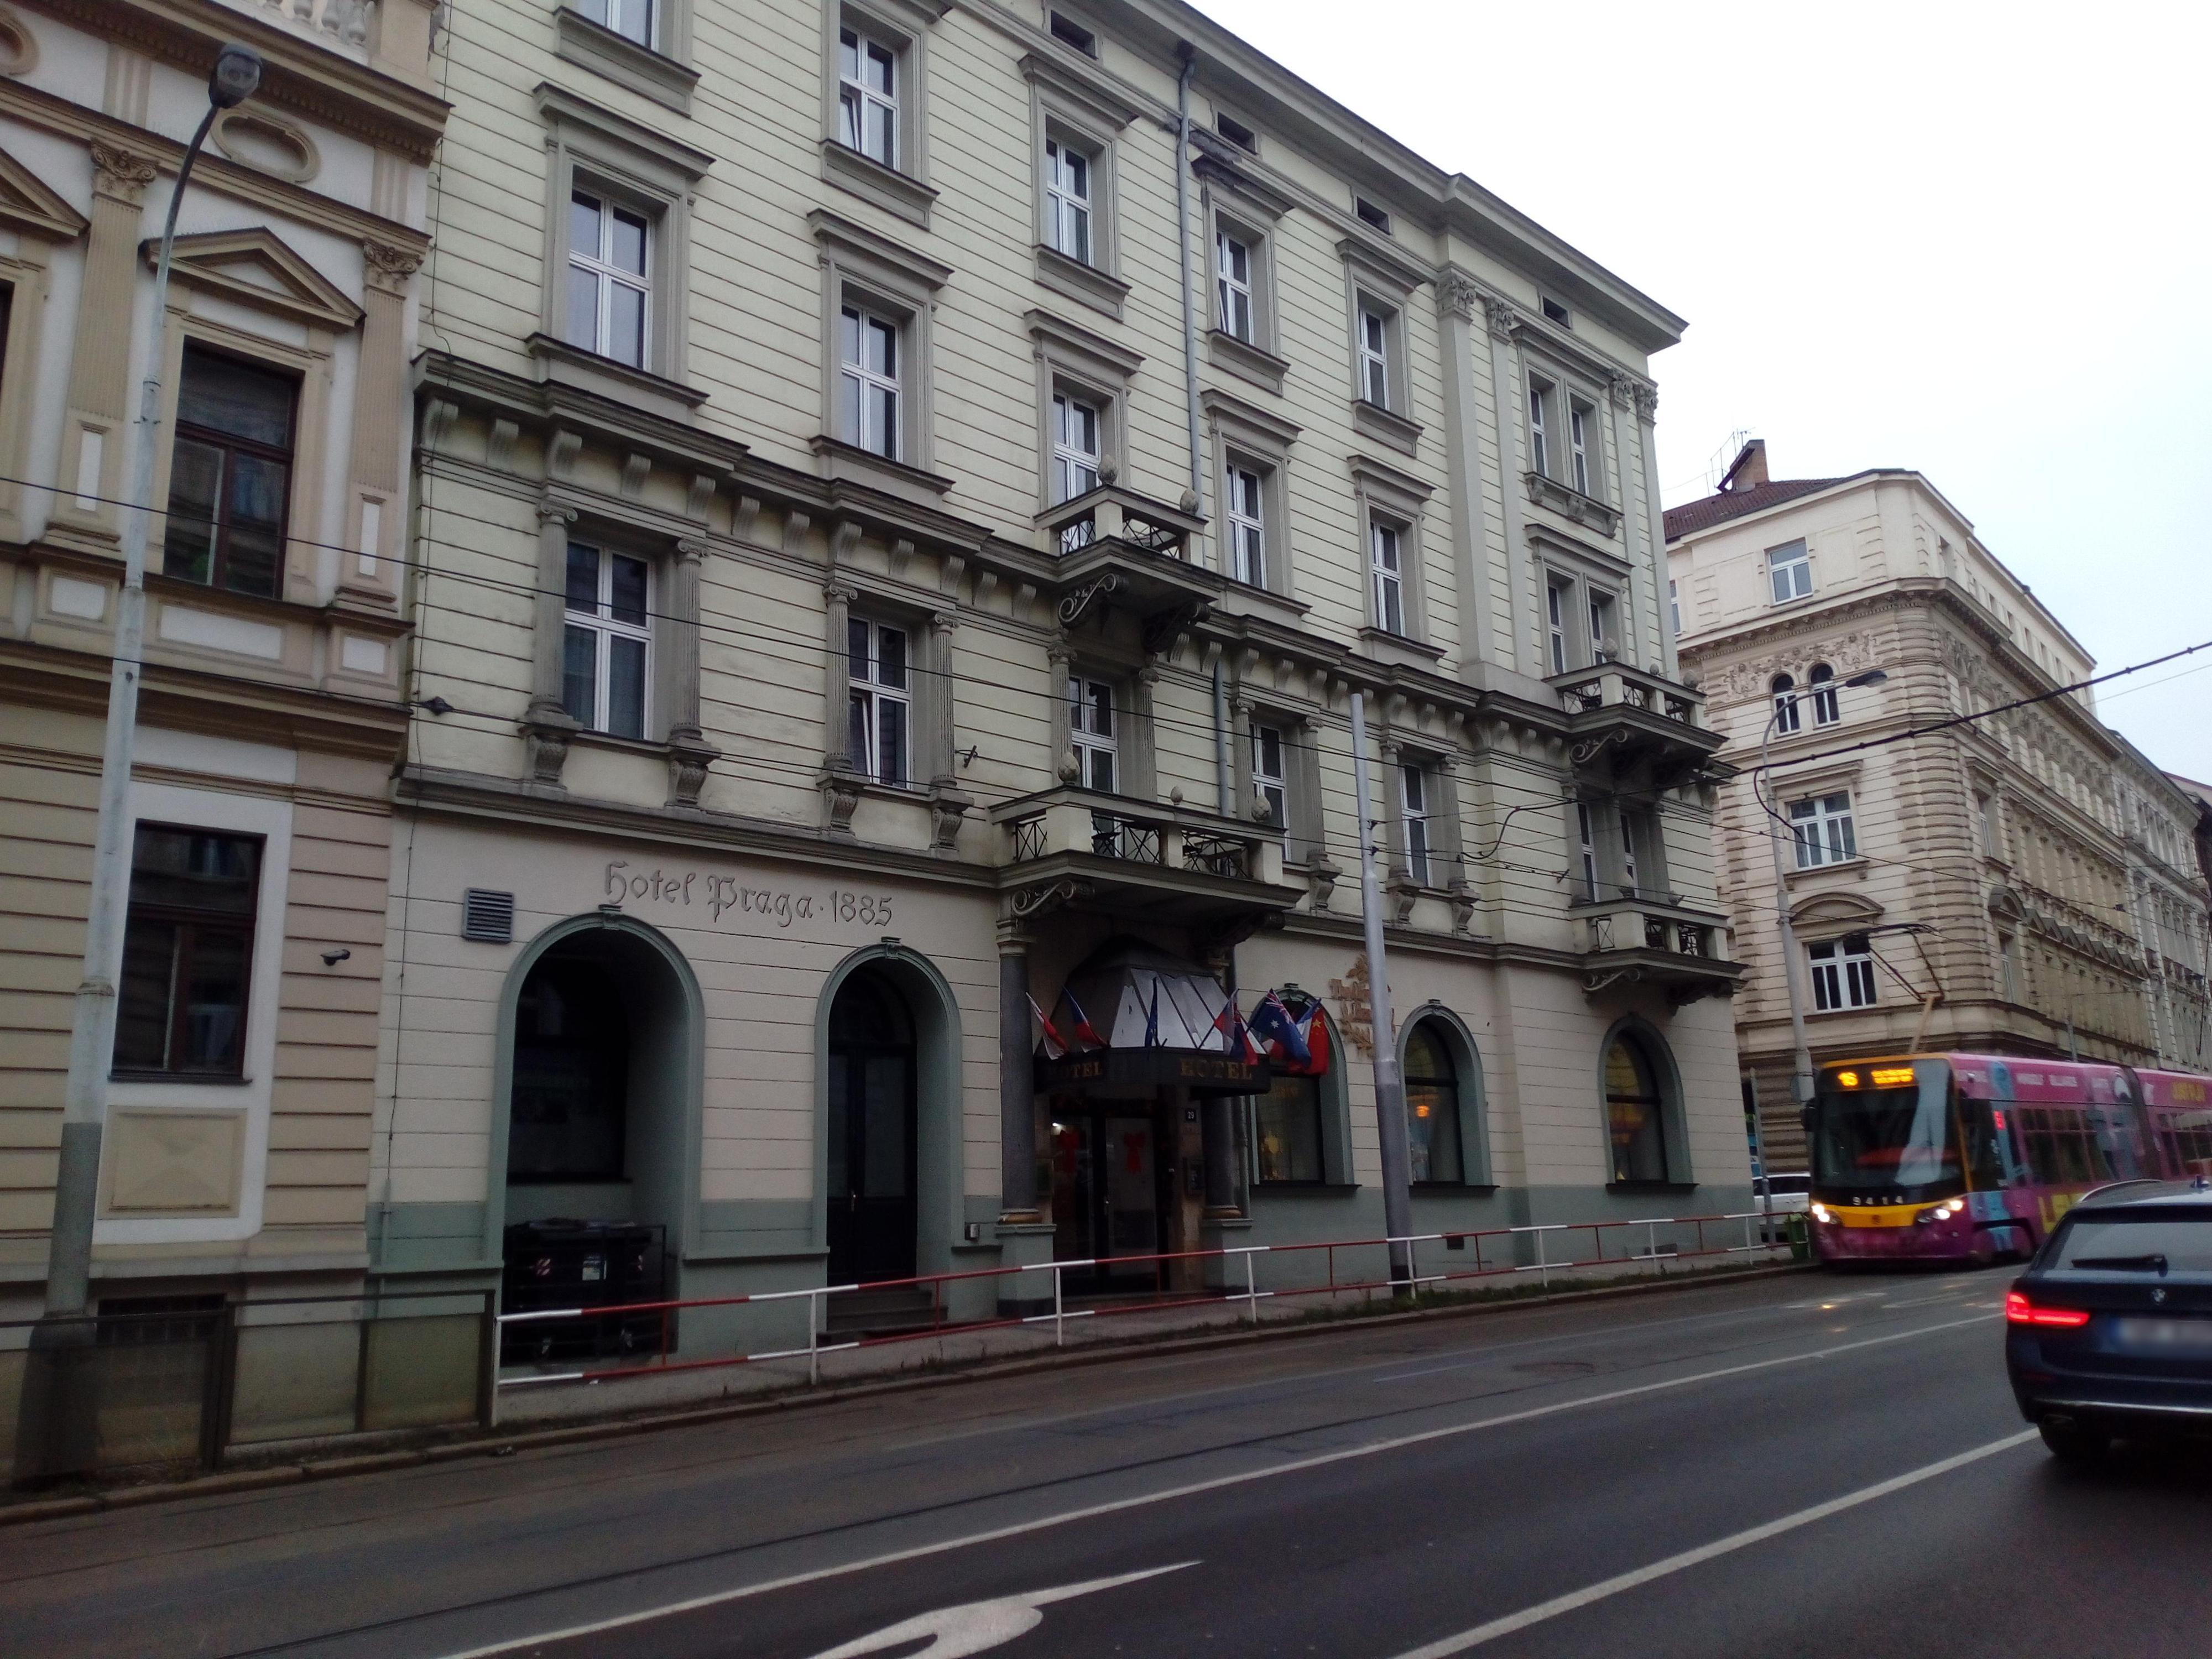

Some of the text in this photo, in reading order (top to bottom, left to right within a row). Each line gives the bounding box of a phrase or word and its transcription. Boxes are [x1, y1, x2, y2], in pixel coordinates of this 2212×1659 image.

[604, 860, 696, 905] Hotel
[830, 890, 893, 926] 1885
[1179, 1058, 1253, 1080] HOTEL
